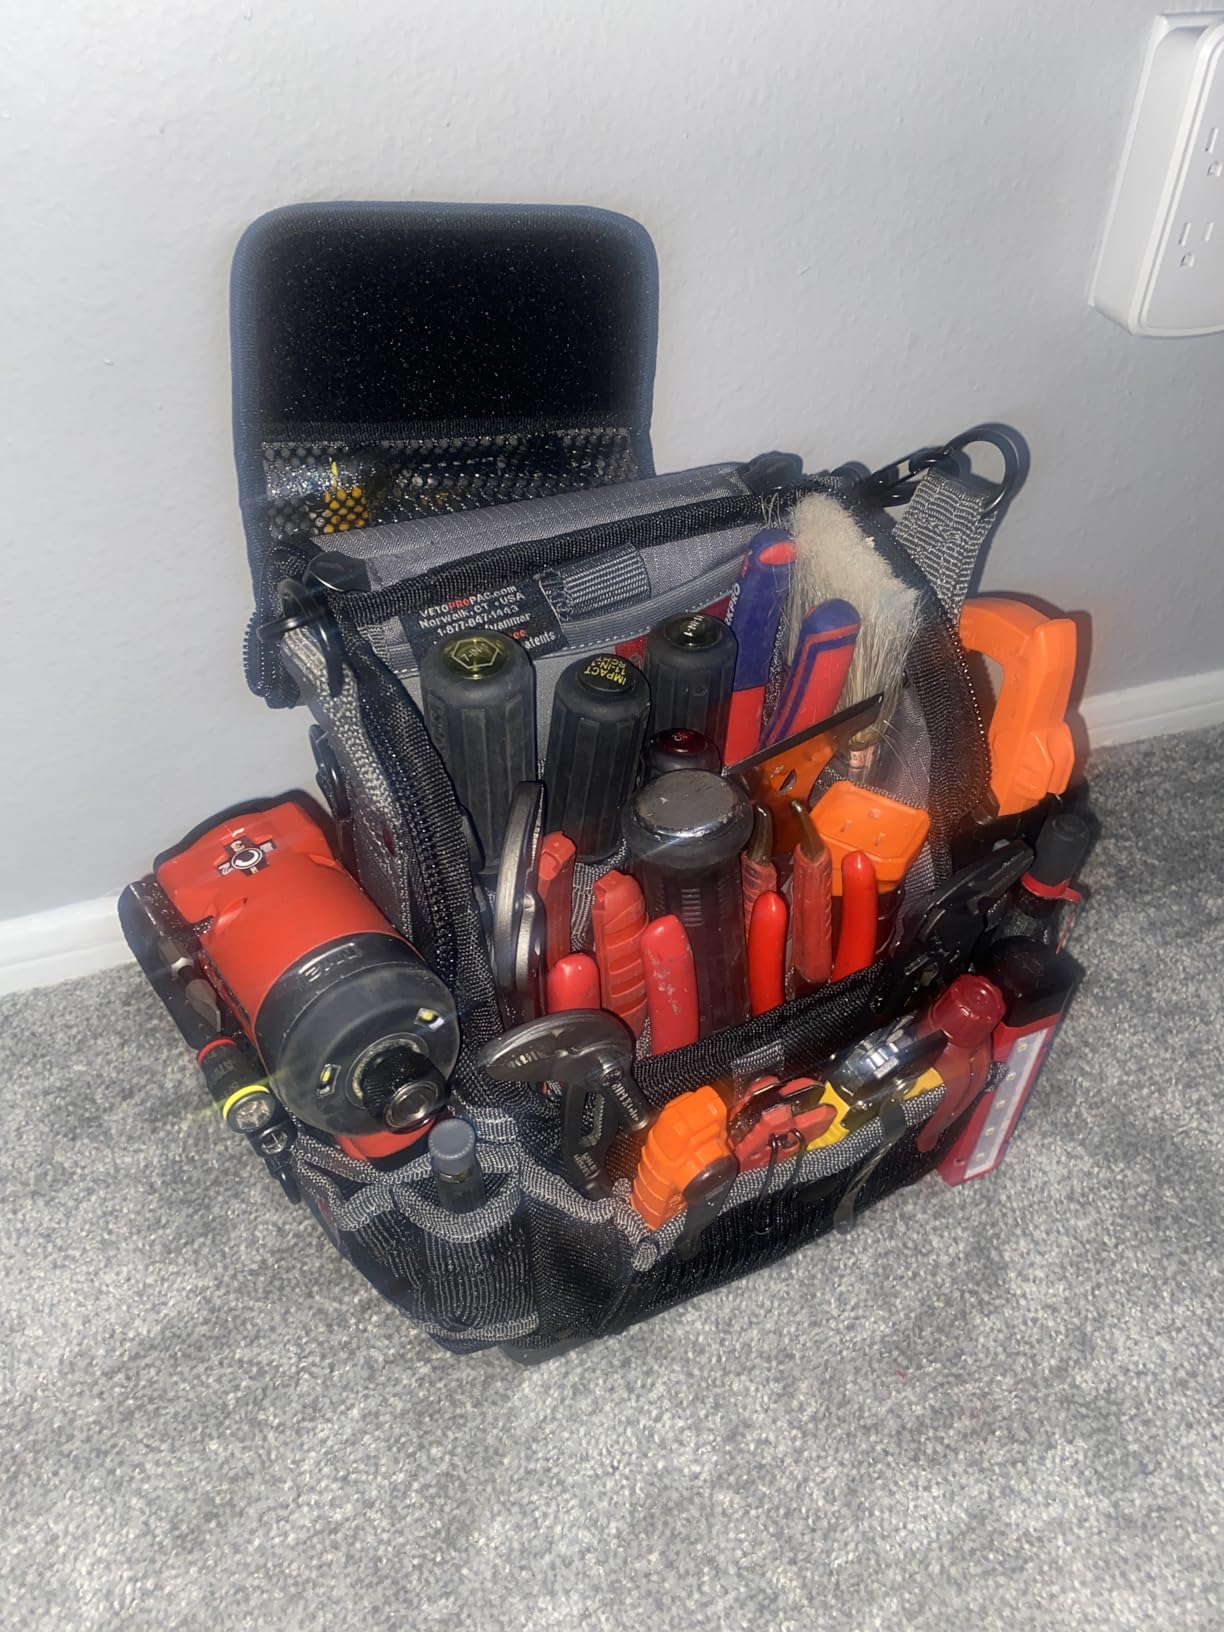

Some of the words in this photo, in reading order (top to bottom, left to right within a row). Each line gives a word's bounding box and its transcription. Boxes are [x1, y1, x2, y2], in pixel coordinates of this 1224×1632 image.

[419, 585, 517, 618] VETOPROPAC.com
[499, 592, 526, 606] USA
[724, 583, 741, 626] RKPRO
[523, 630, 557, 650] atents
[584, 666, 627, 686] IMPACT
